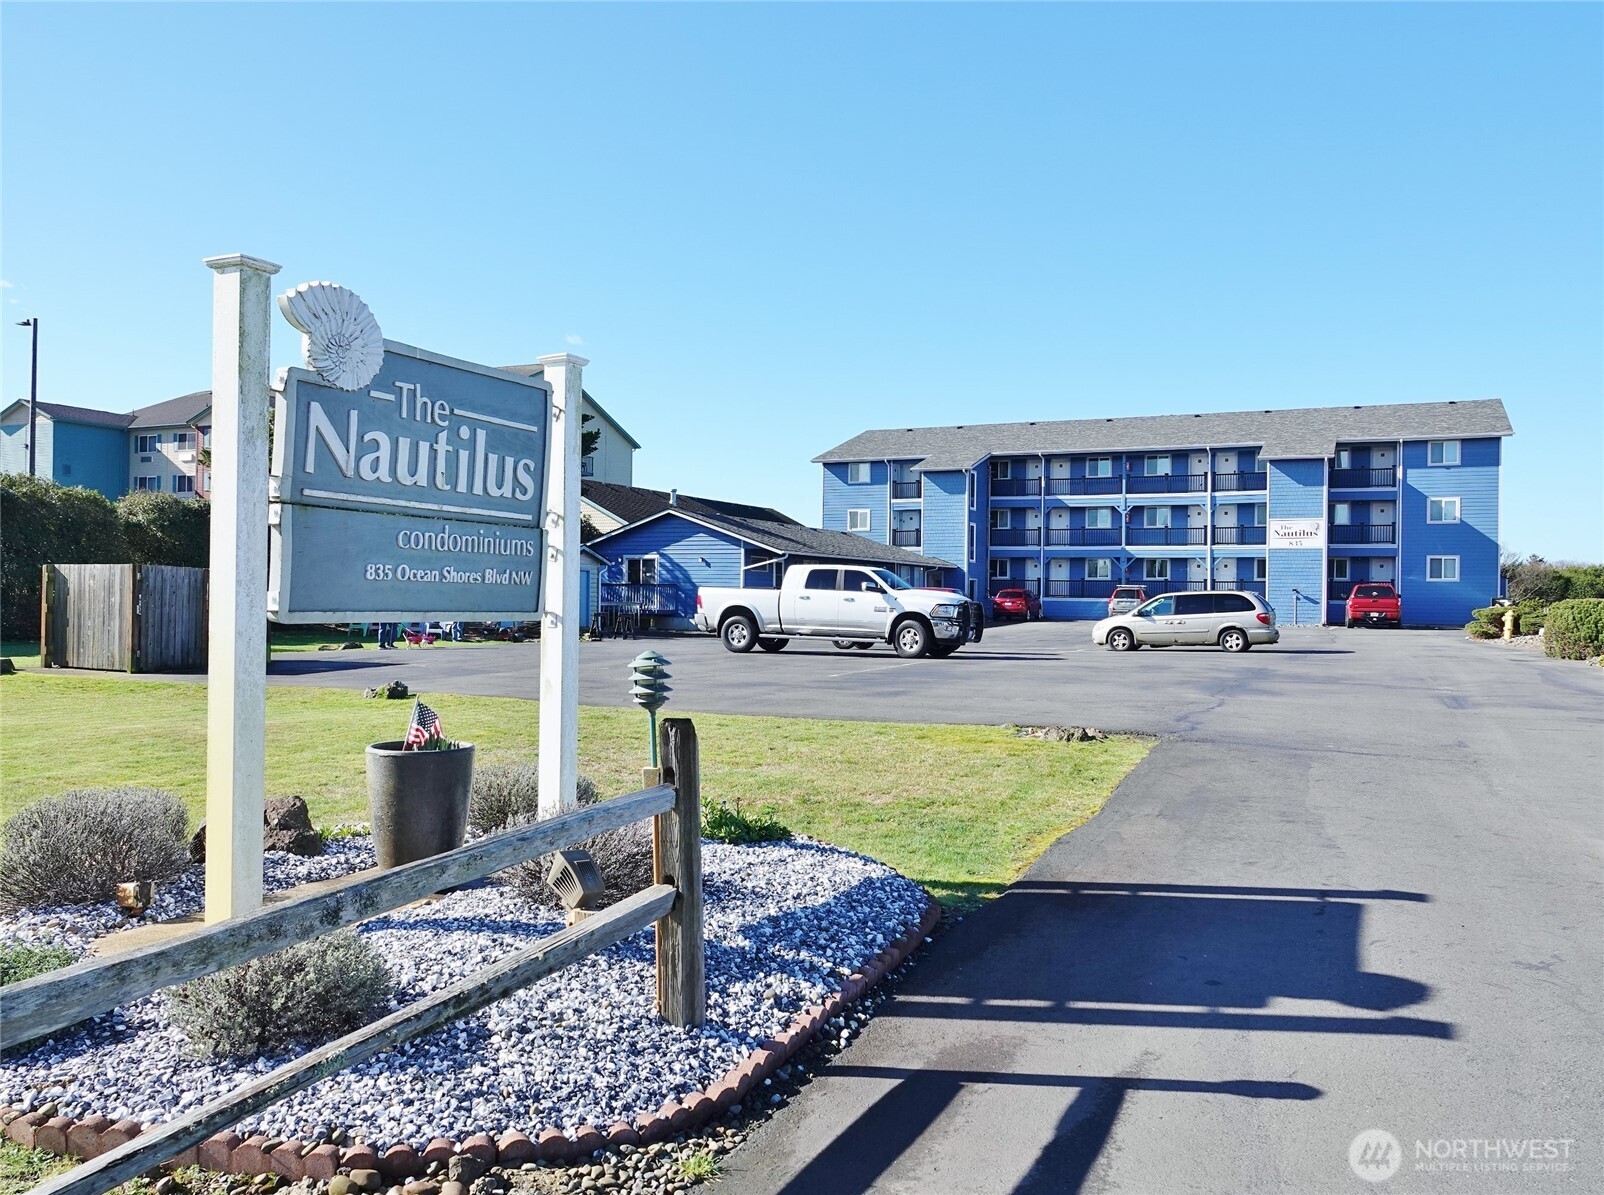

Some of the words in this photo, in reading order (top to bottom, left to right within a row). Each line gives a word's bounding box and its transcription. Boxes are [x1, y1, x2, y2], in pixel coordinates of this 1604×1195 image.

[394, 381, 450, 427] The
[304, 401, 537, 501] Nautilus
[397, 525, 534, 557] condominiums
[1274, 529, 1319, 537] Nautilus
[365, 563, 393, 581] 835
[396, 564, 439, 583] Ocean
[441, 566, 482, 584] Shores
[484, 568, 510, 585] Blvd
[511, 570, 533, 586] NW
